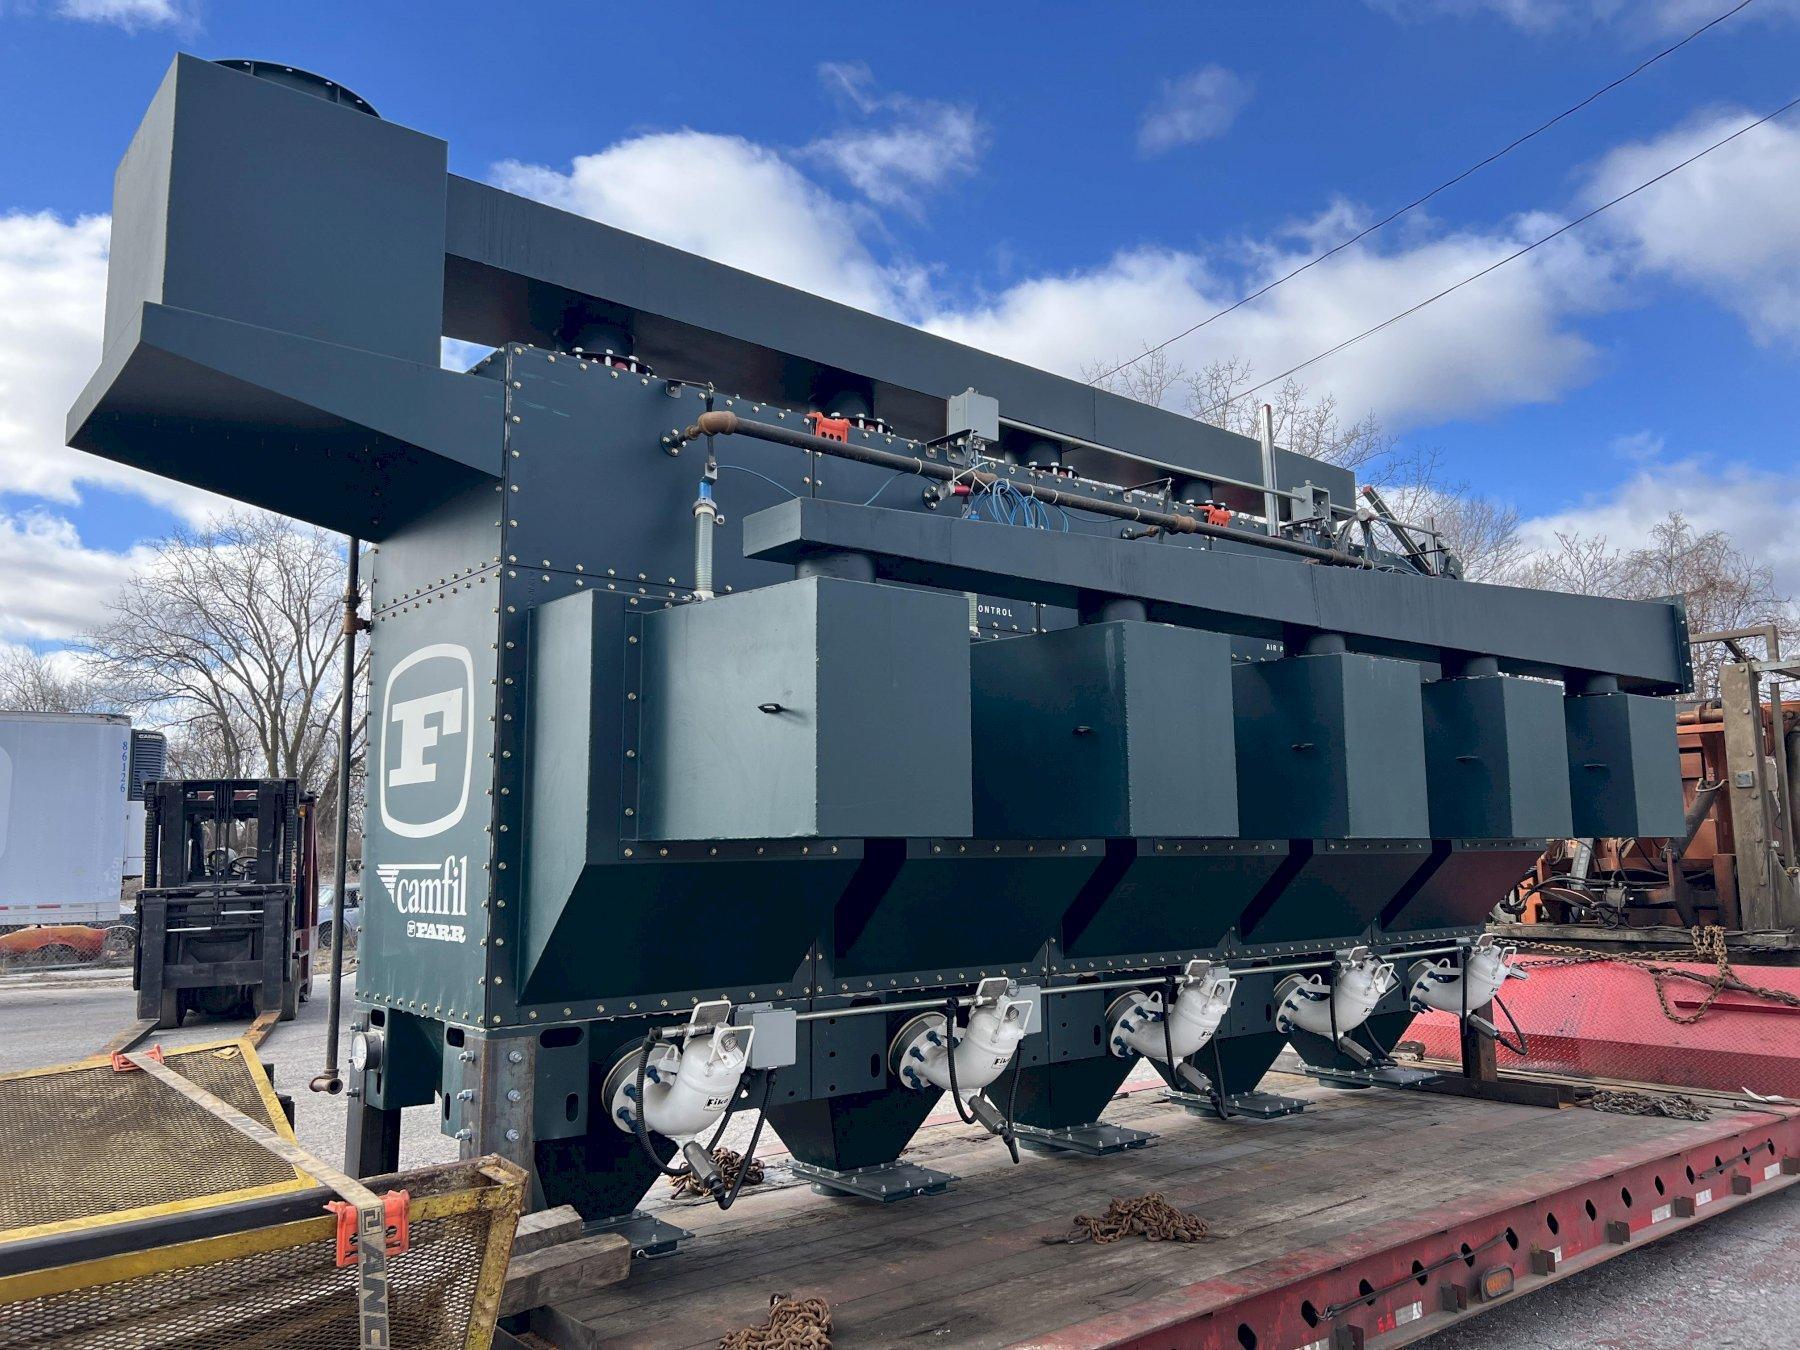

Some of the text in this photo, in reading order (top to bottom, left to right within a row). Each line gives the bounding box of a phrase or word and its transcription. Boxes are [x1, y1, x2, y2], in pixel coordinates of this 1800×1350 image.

[978, 605, 1012, 617] ONTROL
[389, 688, 463, 787] F
[397, 855, 467, 915] camfil
[416, 922, 466, 943] FARR
